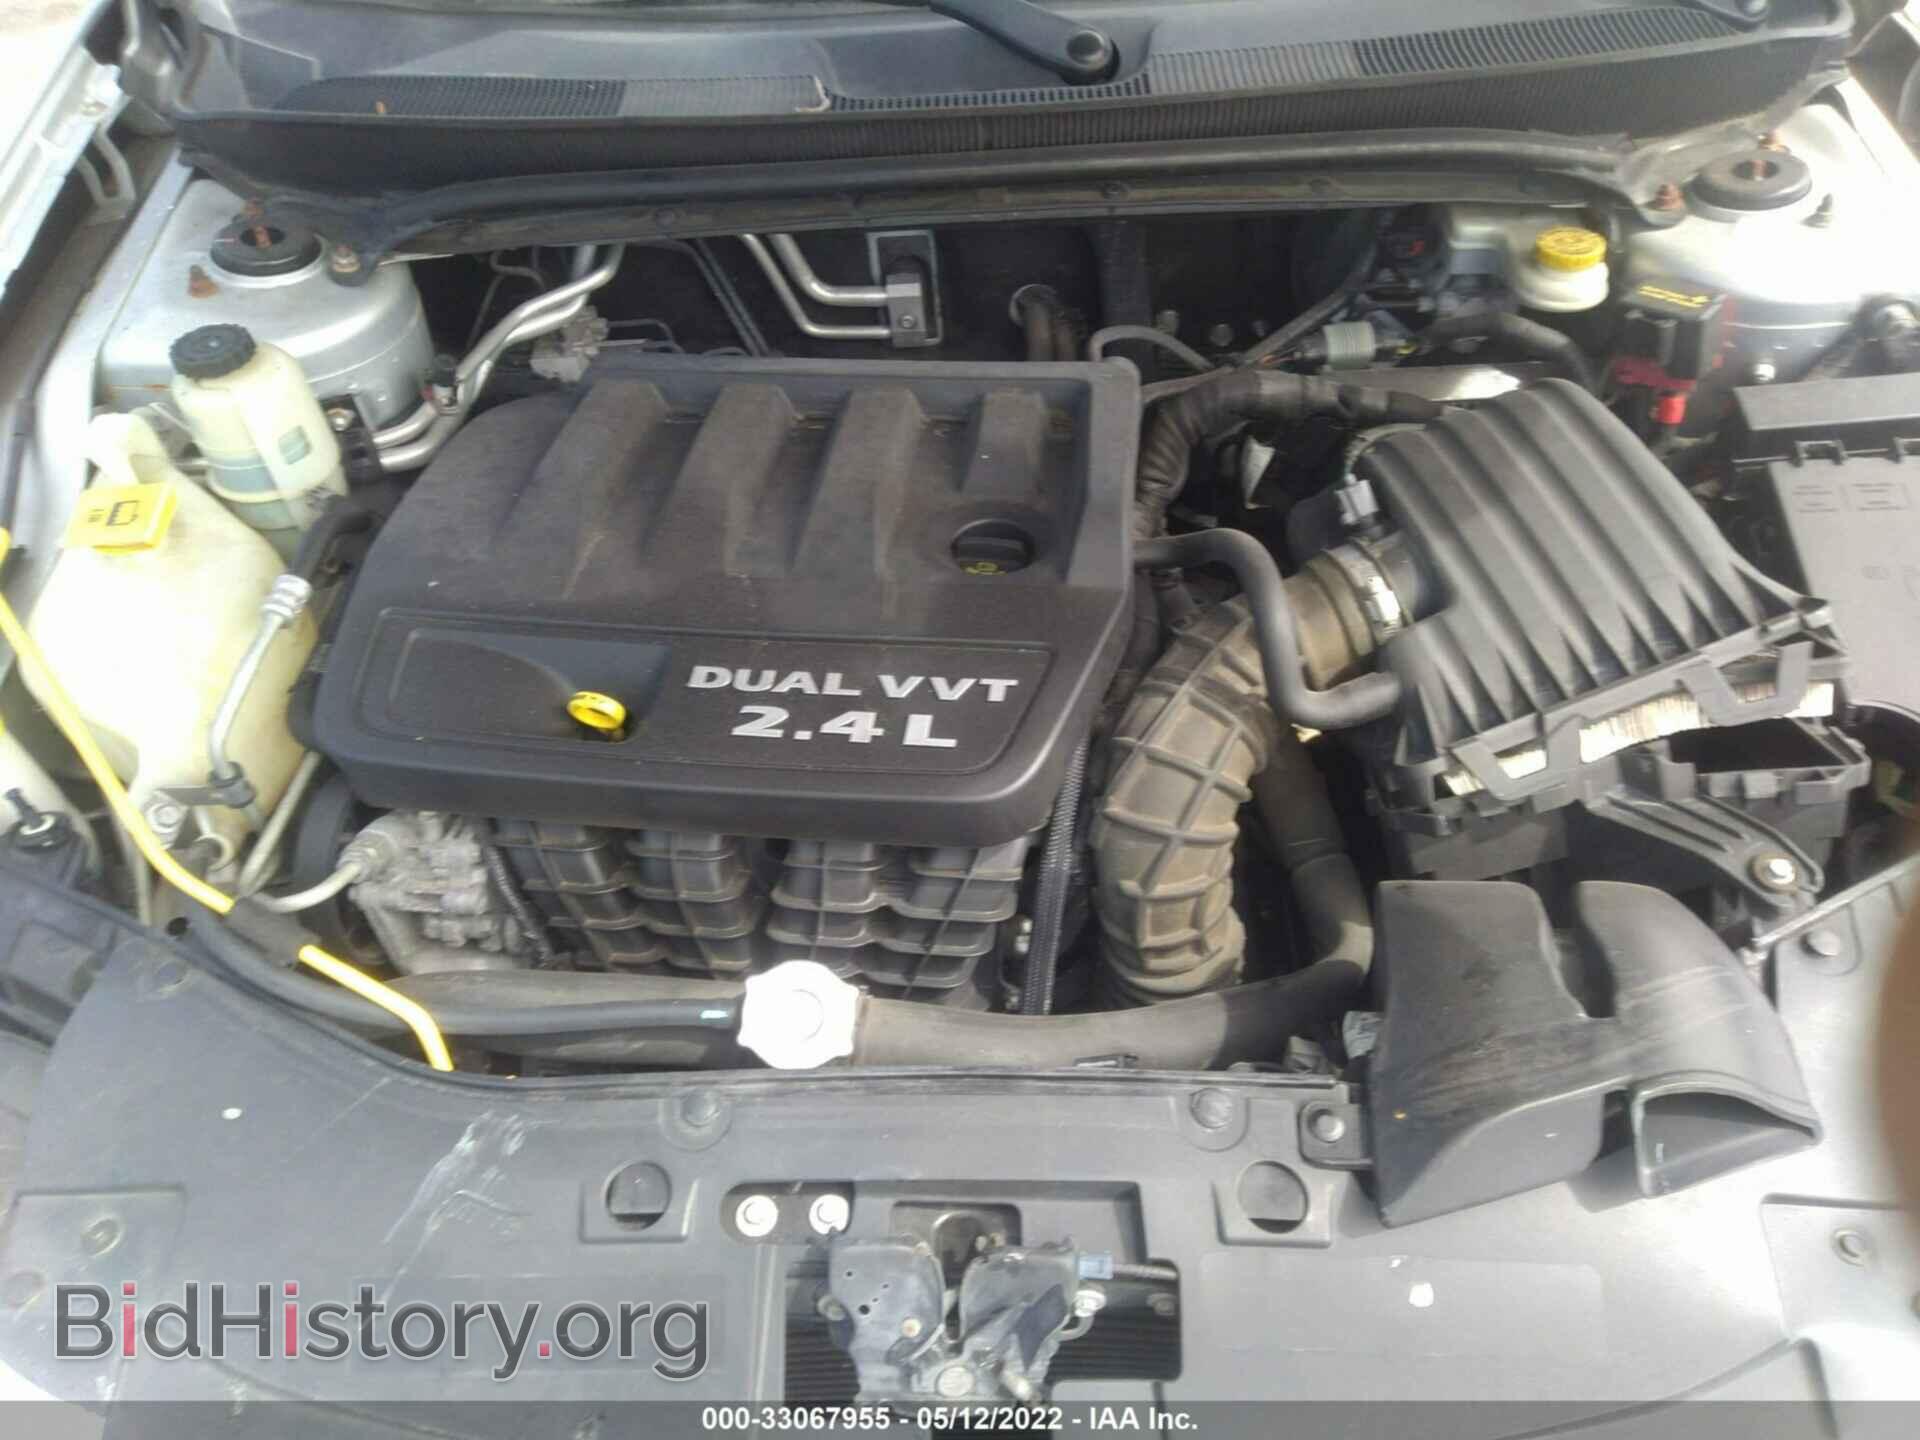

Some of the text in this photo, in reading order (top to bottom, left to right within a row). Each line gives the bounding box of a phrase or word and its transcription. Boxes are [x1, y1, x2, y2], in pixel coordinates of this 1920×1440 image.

[687, 665, 1019, 702] DUAL VVT
[731, 705, 885, 743] 2.4
